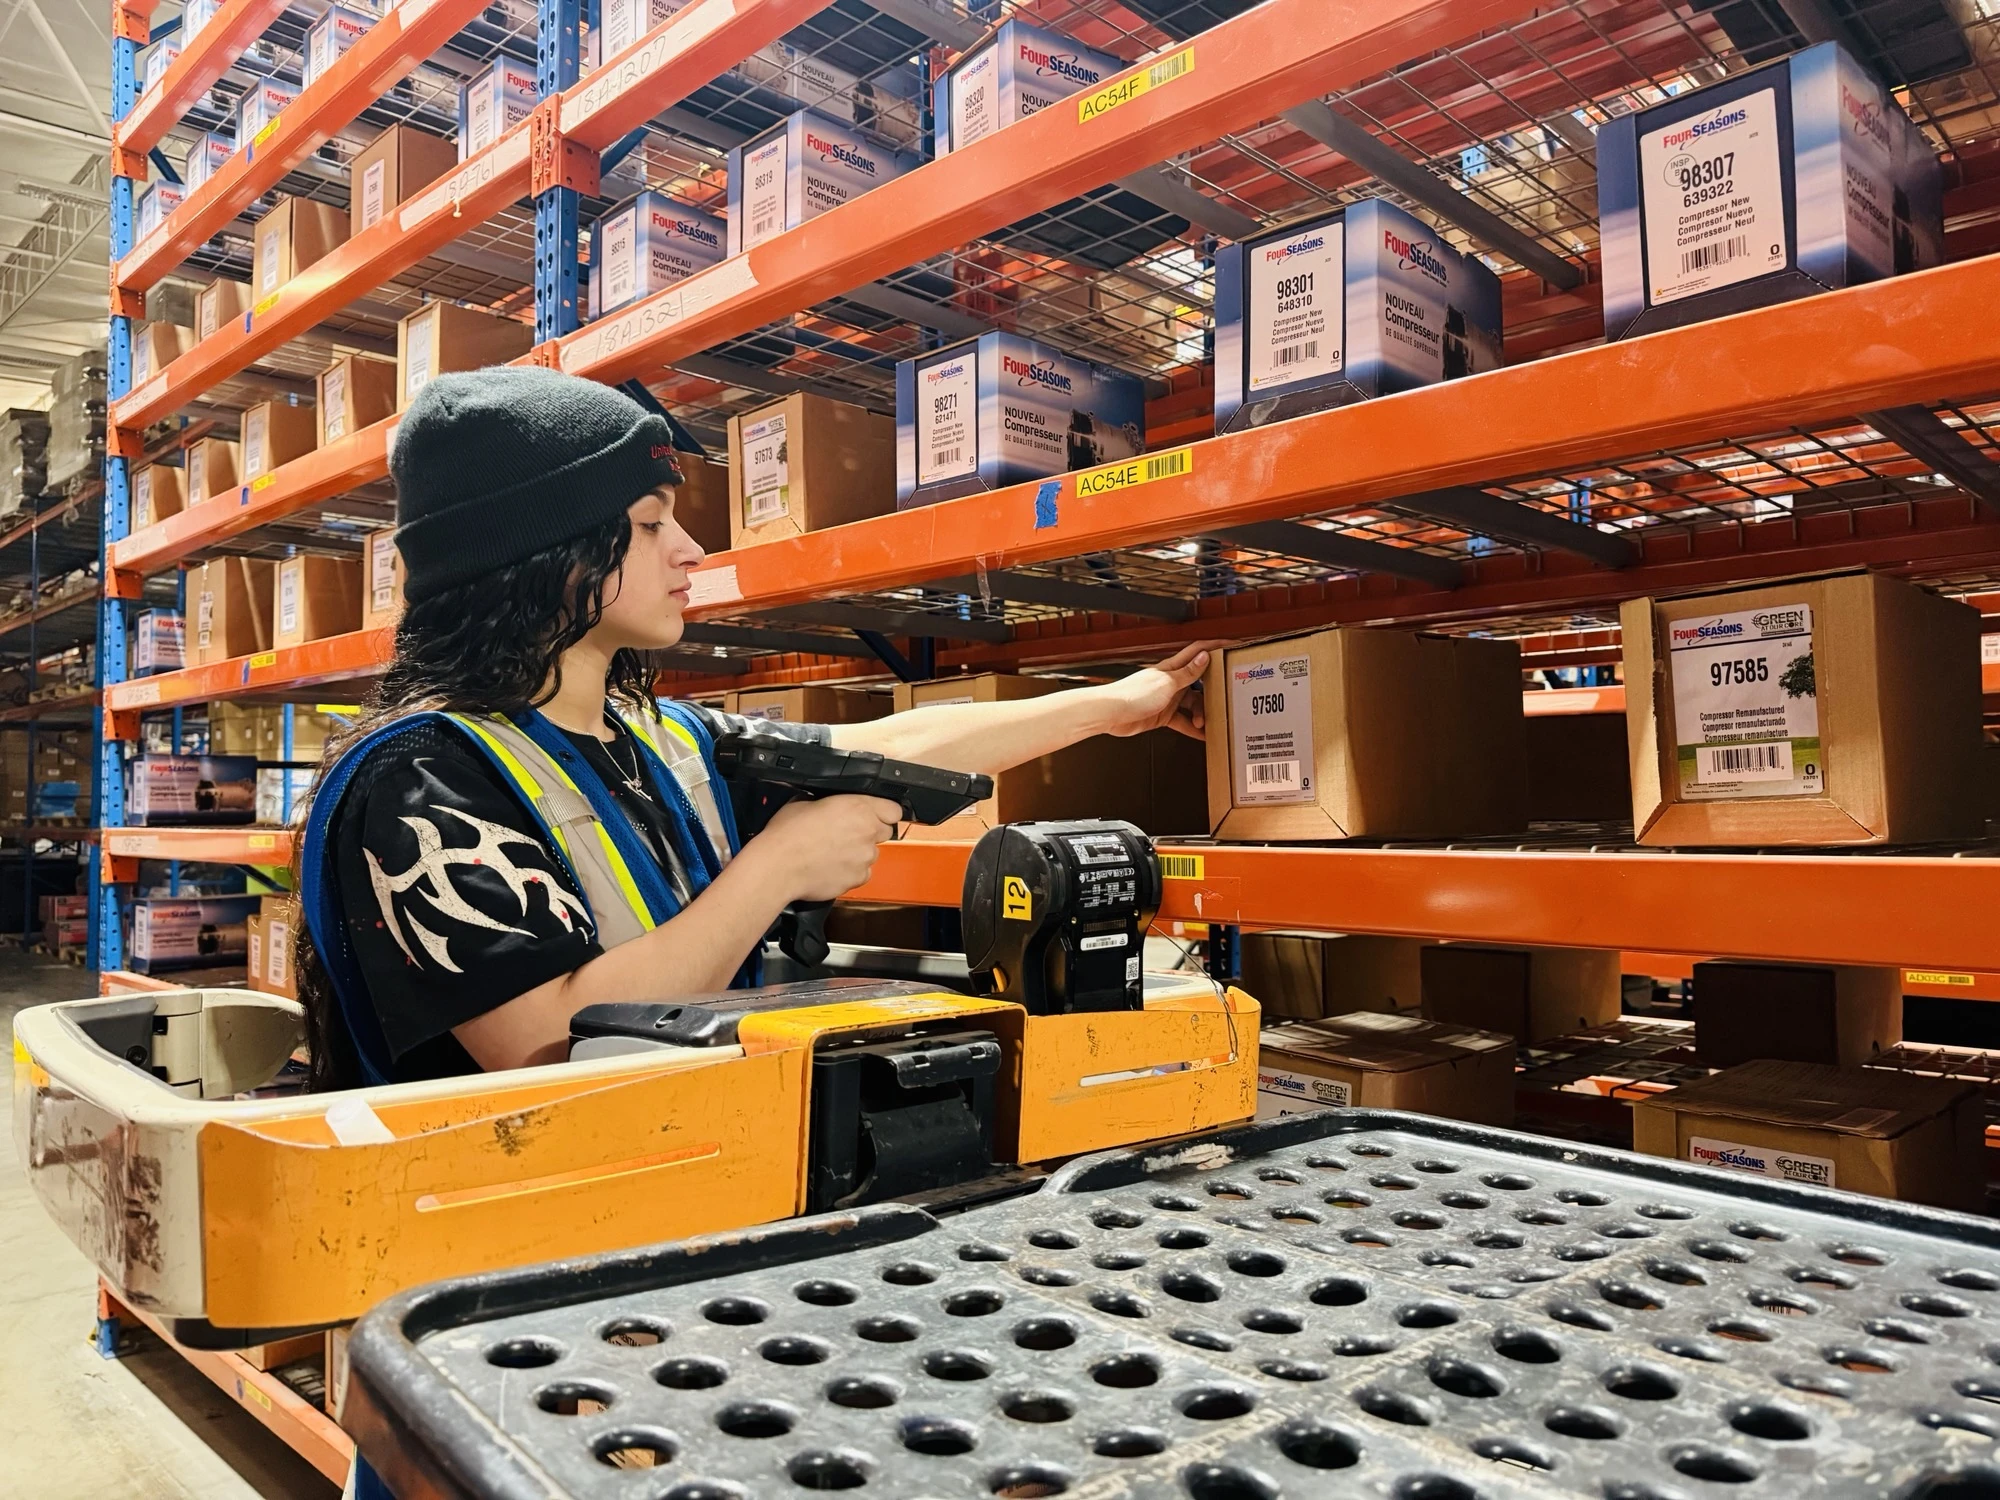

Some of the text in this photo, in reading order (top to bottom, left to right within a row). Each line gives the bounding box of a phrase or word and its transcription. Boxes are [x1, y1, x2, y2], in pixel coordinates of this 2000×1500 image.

[1083, 77, 1139, 120] AC54F
[1663, 109, 1746, 148] FOURSEASONS
[807, 134, 875, 173] FOURSEASONS
[1670, 157, 1690, 170] INSP
[1680, 152, 1735, 192] 98307
[1846, 163, 1876, 199] NOUVEAU
[808, 177, 847, 198] NOUVEAU
[1684, 180, 1734, 208] 639322
[1679, 196, 1750, 226] Compressor New
[1847, 180, 1890, 229] Compresseur
[652, 213, 718, 245] FOURSEASONS
[1677, 215, 1755, 247] Compresseur Neuf
[1678, 206, 1753, 237] Compresor Nuevo
[653, 250, 691, 269] NOUVEAU
[1267, 237, 1324, 262] FOURSEASONS
[1385, 230, 1447, 281] FOURSEASONS
[1277, 272, 1314, 300] 98301
[1278, 294, 1312, 313] 648310
[1386, 293, 1424, 320] NOUVEAU
[1273, 318, 1324, 336] Compresor Nuevo
[1274, 309, 1322, 328] Compressor New
[1385, 307, 1439, 344] Compresseur
[1271, 325, 1325, 345] Compresseur Neuf
[928, 365, 963, 382] FOURSEASONS
[1004, 356, 1072, 391] FOURSEASONS
[935, 393, 957, 413] 98271
[935, 410, 956, 424] 621471
[1005, 406, 1045, 426] NOUVEAU
[1004, 418, 1063, 443] Compresseur
[1005, 434, 1011, 442] DE
[755, 447, 772, 464] 97673
[1080, 466, 1138, 495] AC54E
[1759, 611, 1803, 627] GREEN
[1674, 623, 1743, 640] FOURSEASONS
[1711, 657, 1769, 686] 97585
[1252, 693, 1284, 716] 97580
[1700, 705, 1785, 722] Compressor Remanufactured
[1702, 717, 1786, 733] Compresor remanufacturado
[1705, 729, 1788, 743] Compresseur remanufacture
[1008, 882, 1026, 914] 12
[1317, 1083, 1347, 1096] GREEN
[1694, 1147, 1765, 1169] FOURSEASONS
[1782, 1159, 1829, 1177] GREEN
